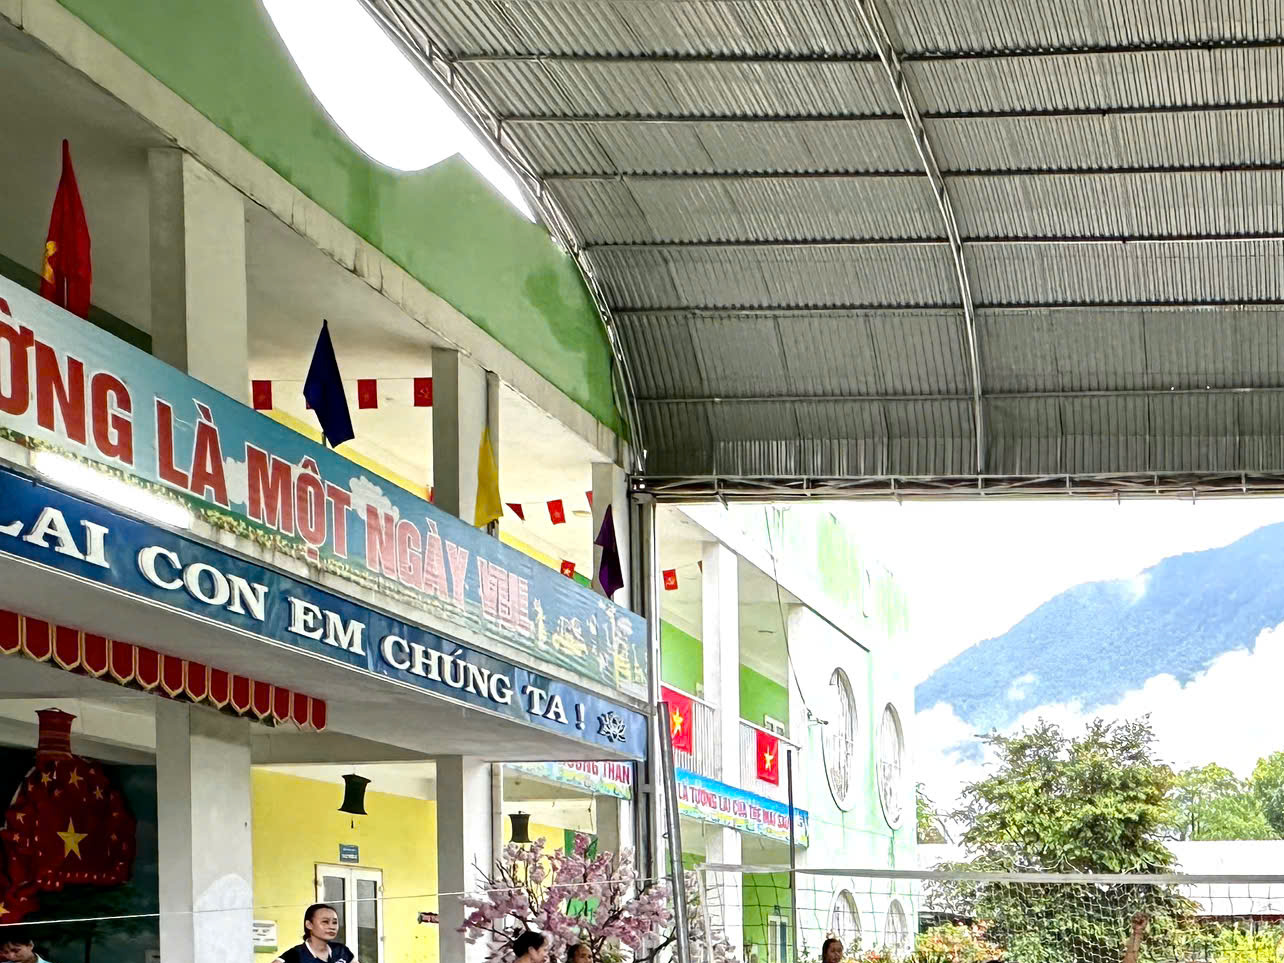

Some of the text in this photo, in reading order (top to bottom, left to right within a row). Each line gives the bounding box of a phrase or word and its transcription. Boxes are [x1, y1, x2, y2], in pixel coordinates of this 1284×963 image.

[155, 397, 230, 509] LÀ
[245, 441, 352, 564] MỘT
[365, 503, 469, 612] NGÀY
[138, 545, 268, 621] CON
[288, 596, 366, 656] EM
[382, 634, 513, 705] CHÚNG
[524, 685, 569, 724] TA
